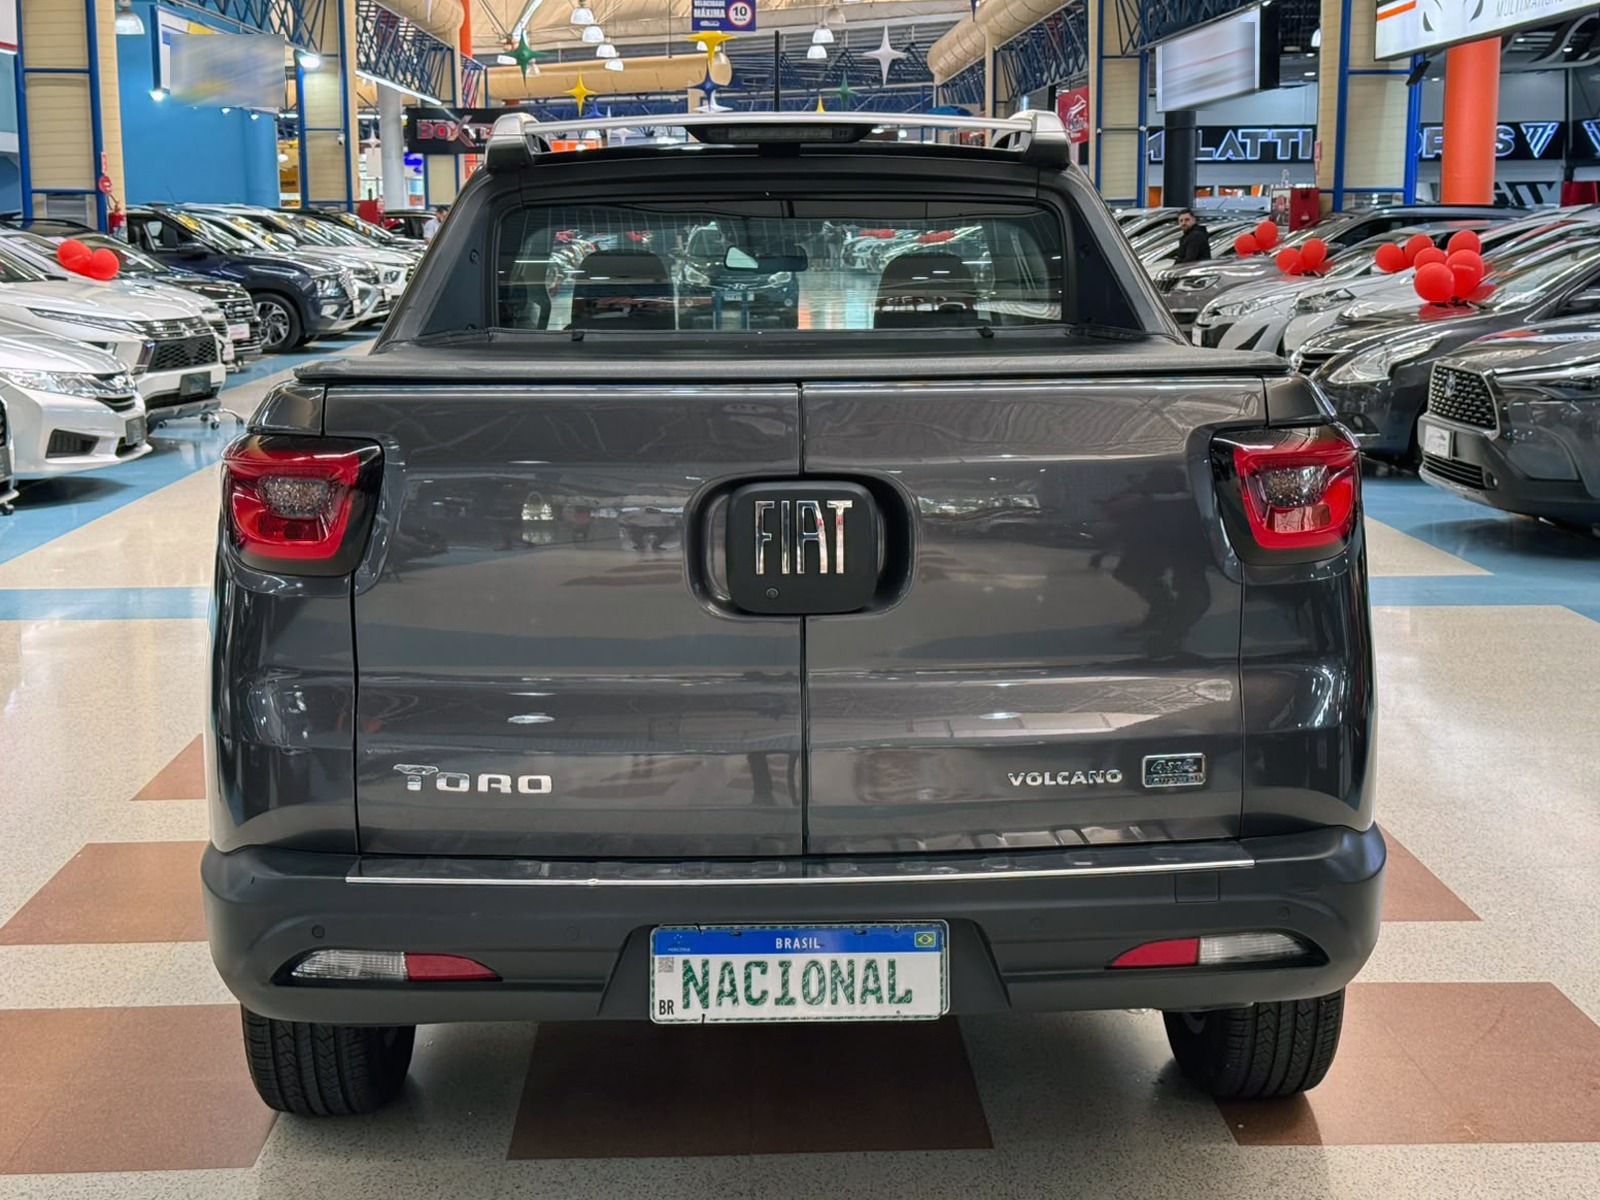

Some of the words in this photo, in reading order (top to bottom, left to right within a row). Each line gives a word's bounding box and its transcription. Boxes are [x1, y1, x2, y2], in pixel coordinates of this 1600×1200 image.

[694, 8, 725, 18] MÁXIMA
[732, 6, 747, 16] 10
[755, 500, 853, 575] FIAT
[393, 764, 552, 794] TORO
[1007, 769, 1123, 786] VOLCANO
[775, 937, 820, 949] BRASIL
[681, 958, 913, 1010] NACIONAL
[658, 1000, 675, 1016] BR
